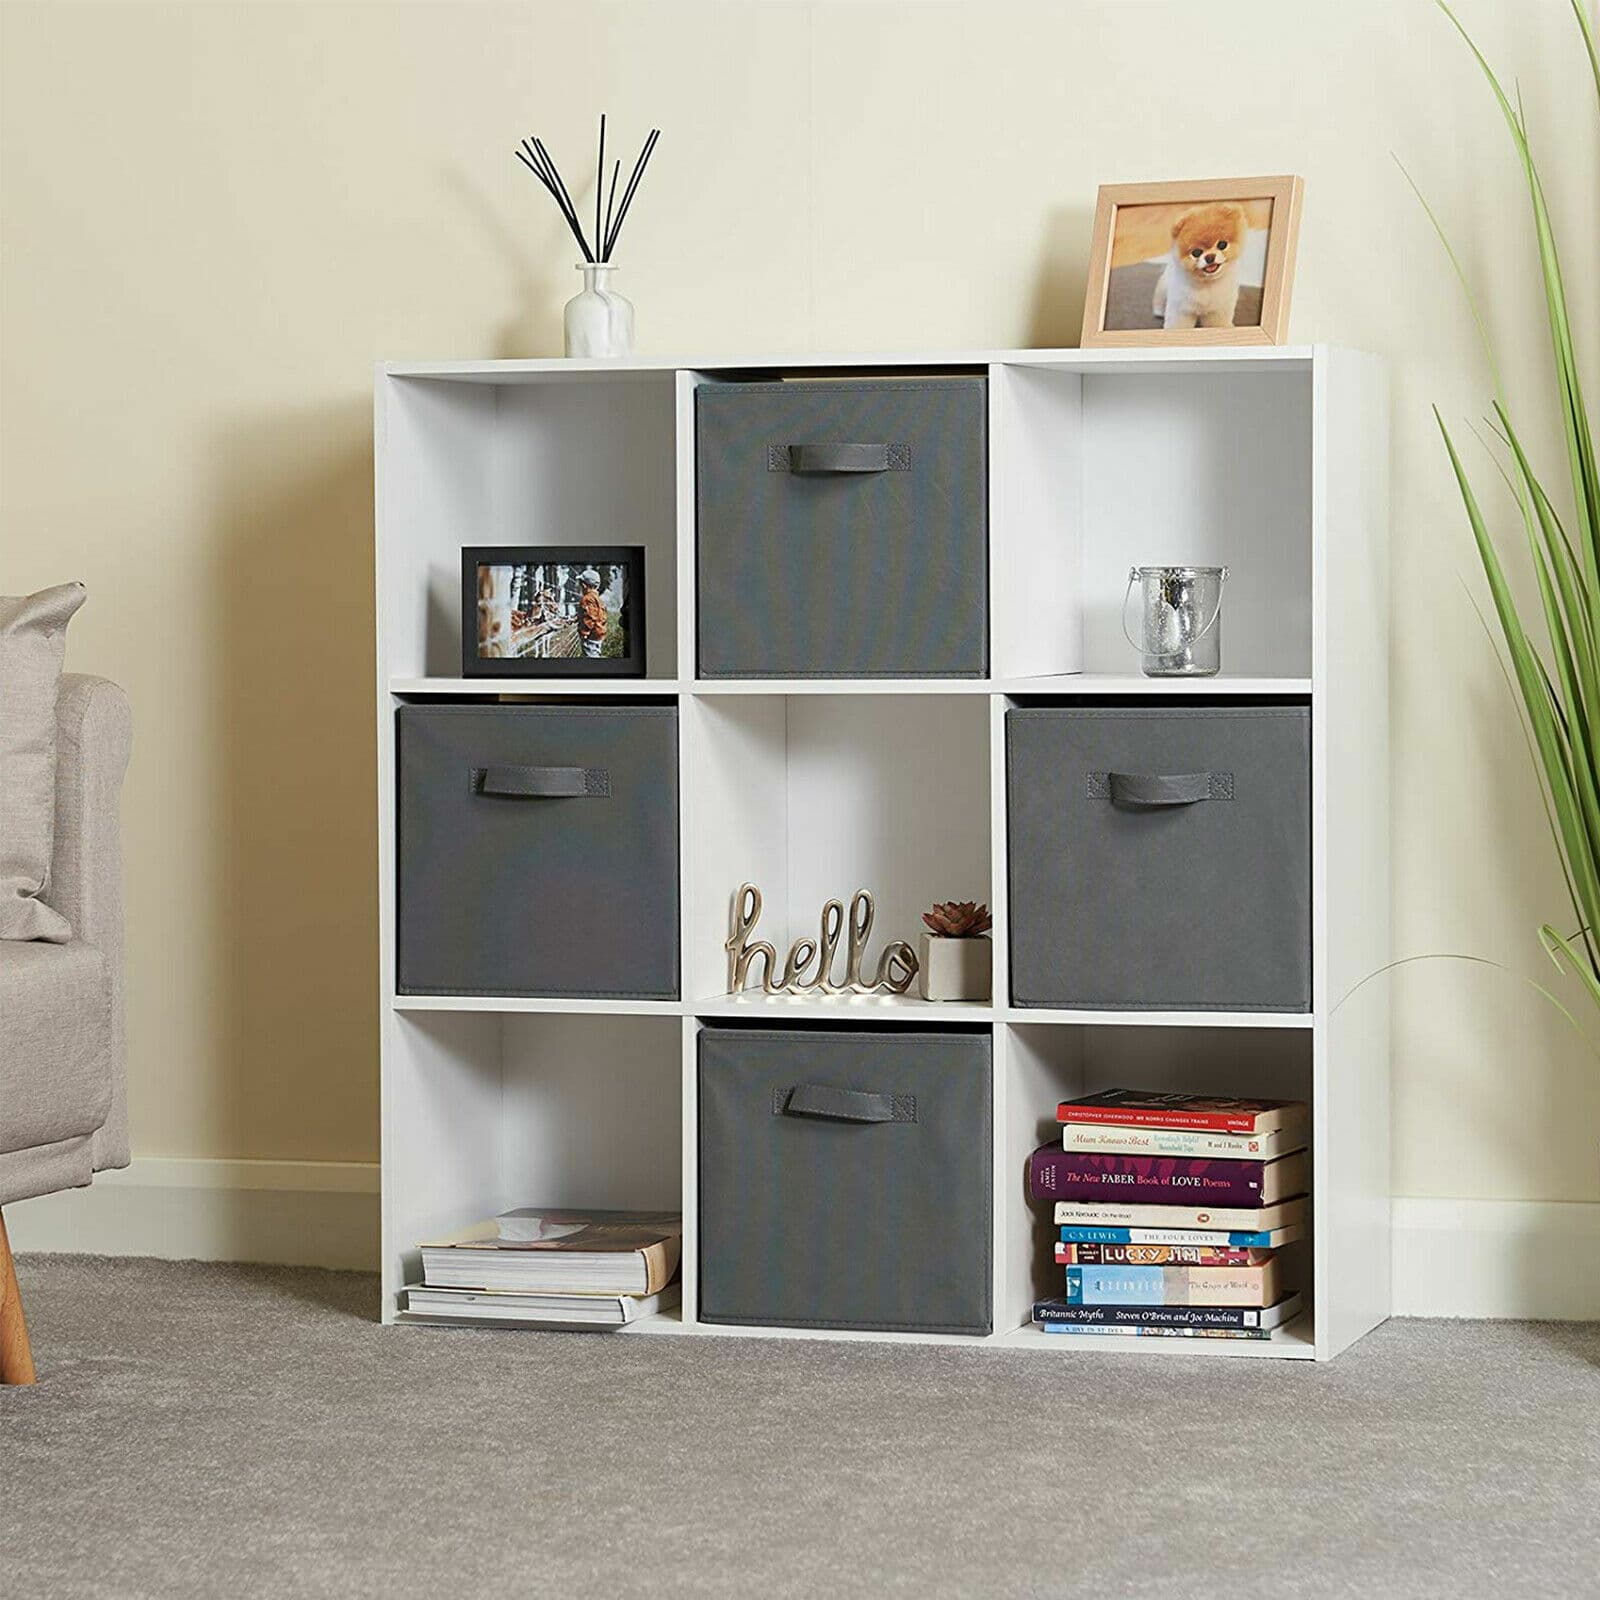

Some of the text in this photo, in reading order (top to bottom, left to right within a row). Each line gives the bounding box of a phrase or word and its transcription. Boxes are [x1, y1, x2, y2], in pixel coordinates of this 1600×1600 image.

[724, 881, 920, 995] hello
[1227, 1119, 1249, 1127] VINTAGE
[1073, 1134, 1096, 1143] Mum
[1098, 1134, 1128, 1144] Knows
[1128, 1136, 1150, 1146] Best
[1066, 1172, 1231, 1188] The New FABER Book of LOVE Poems
[1061, 1210, 1074, 1218] Jack
[1075, 1210, 1099, 1218] Kerouac
[1087, 1232, 1117, 1240] LEWIS
[1104, 1247, 1199, 1262] LUCKY JIM
[1040, 1308, 1104, 1322] Britannic Myths
[1115, 1311, 1239, 1323] Steven O'Brien and Joe Machine
